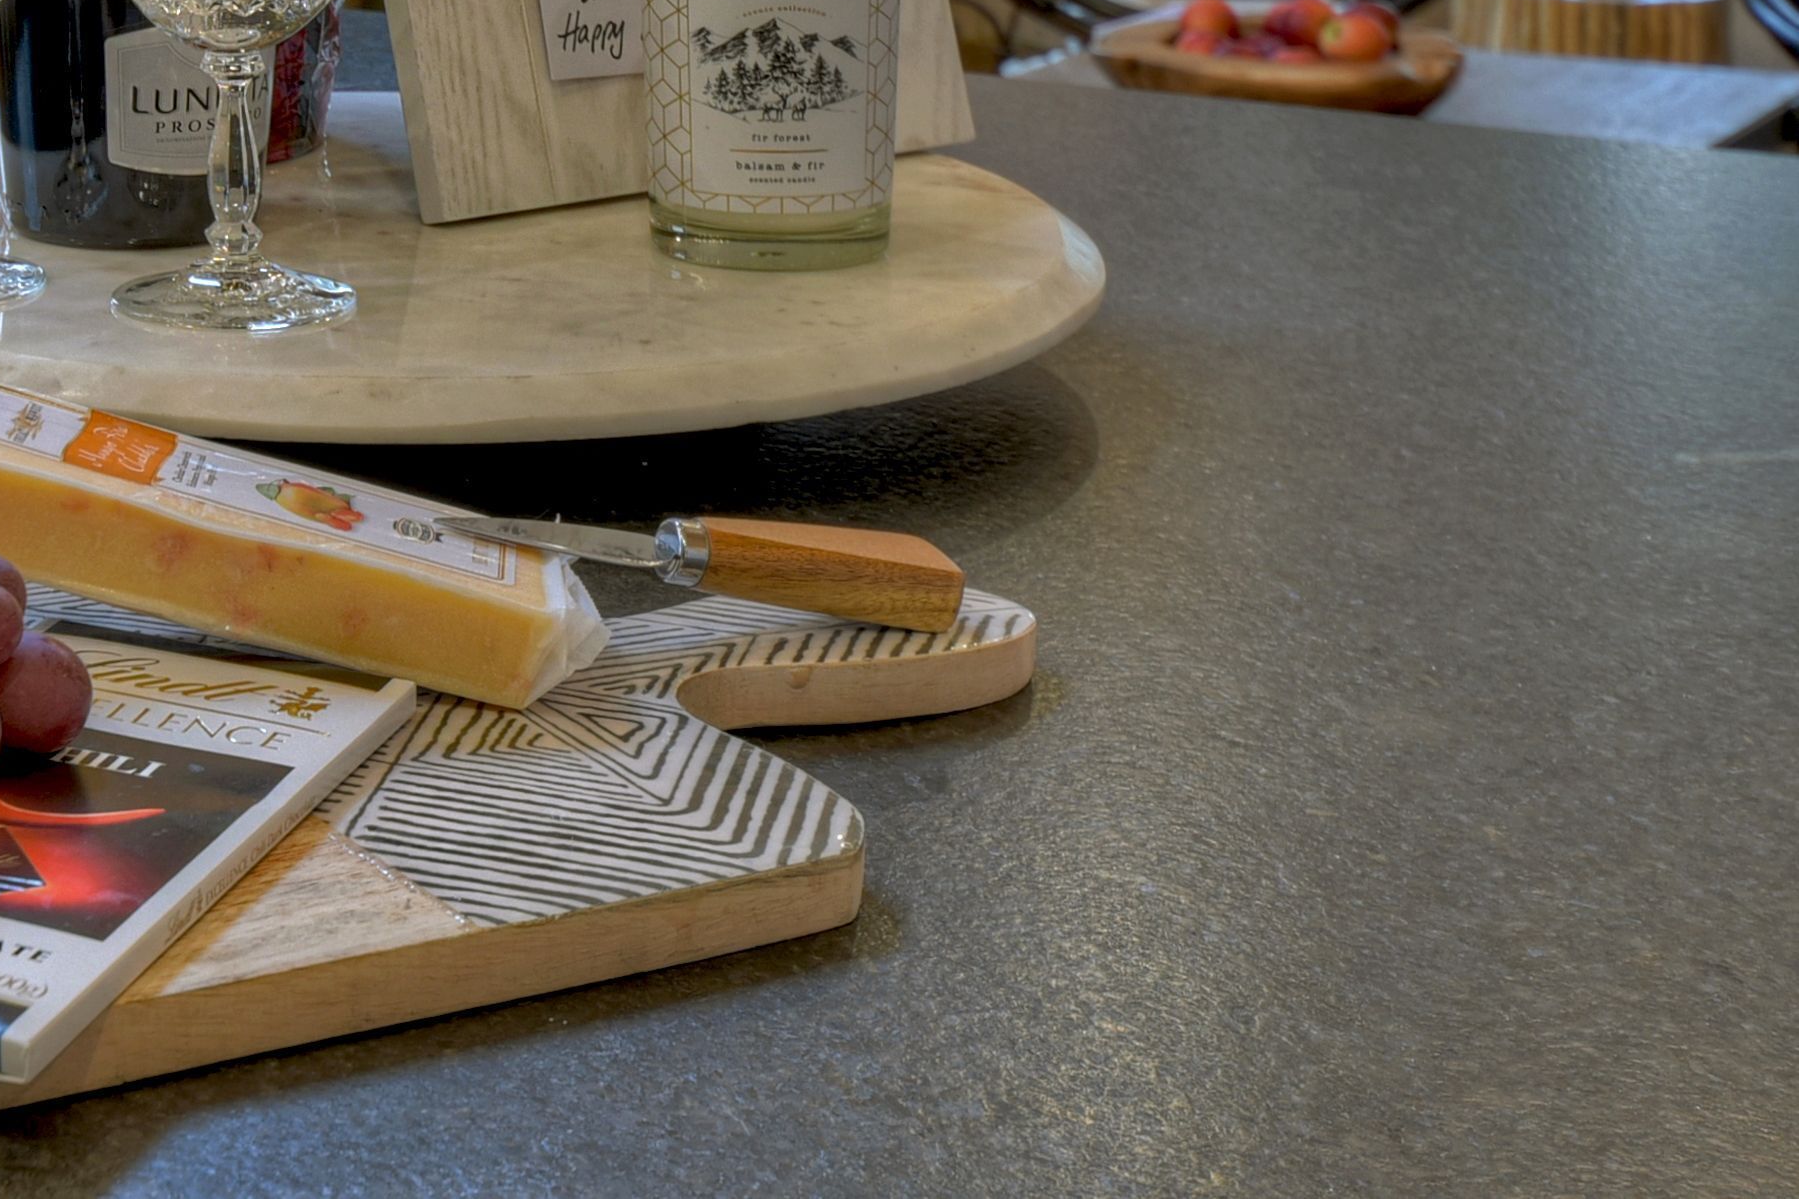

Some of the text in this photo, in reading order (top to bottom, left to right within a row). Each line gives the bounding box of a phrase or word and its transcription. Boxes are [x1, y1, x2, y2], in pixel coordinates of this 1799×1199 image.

[557, 10, 625, 60] Happy
[131, 73, 269, 116] LUNTA
[155, 107, 262, 134] PROSO
[752, 133, 811, 143] fir forest
[735, 160, 825, 172] balsam & fir
[92, 697, 292, 751] ELLENCE
[50, 746, 167, 779] HILI
